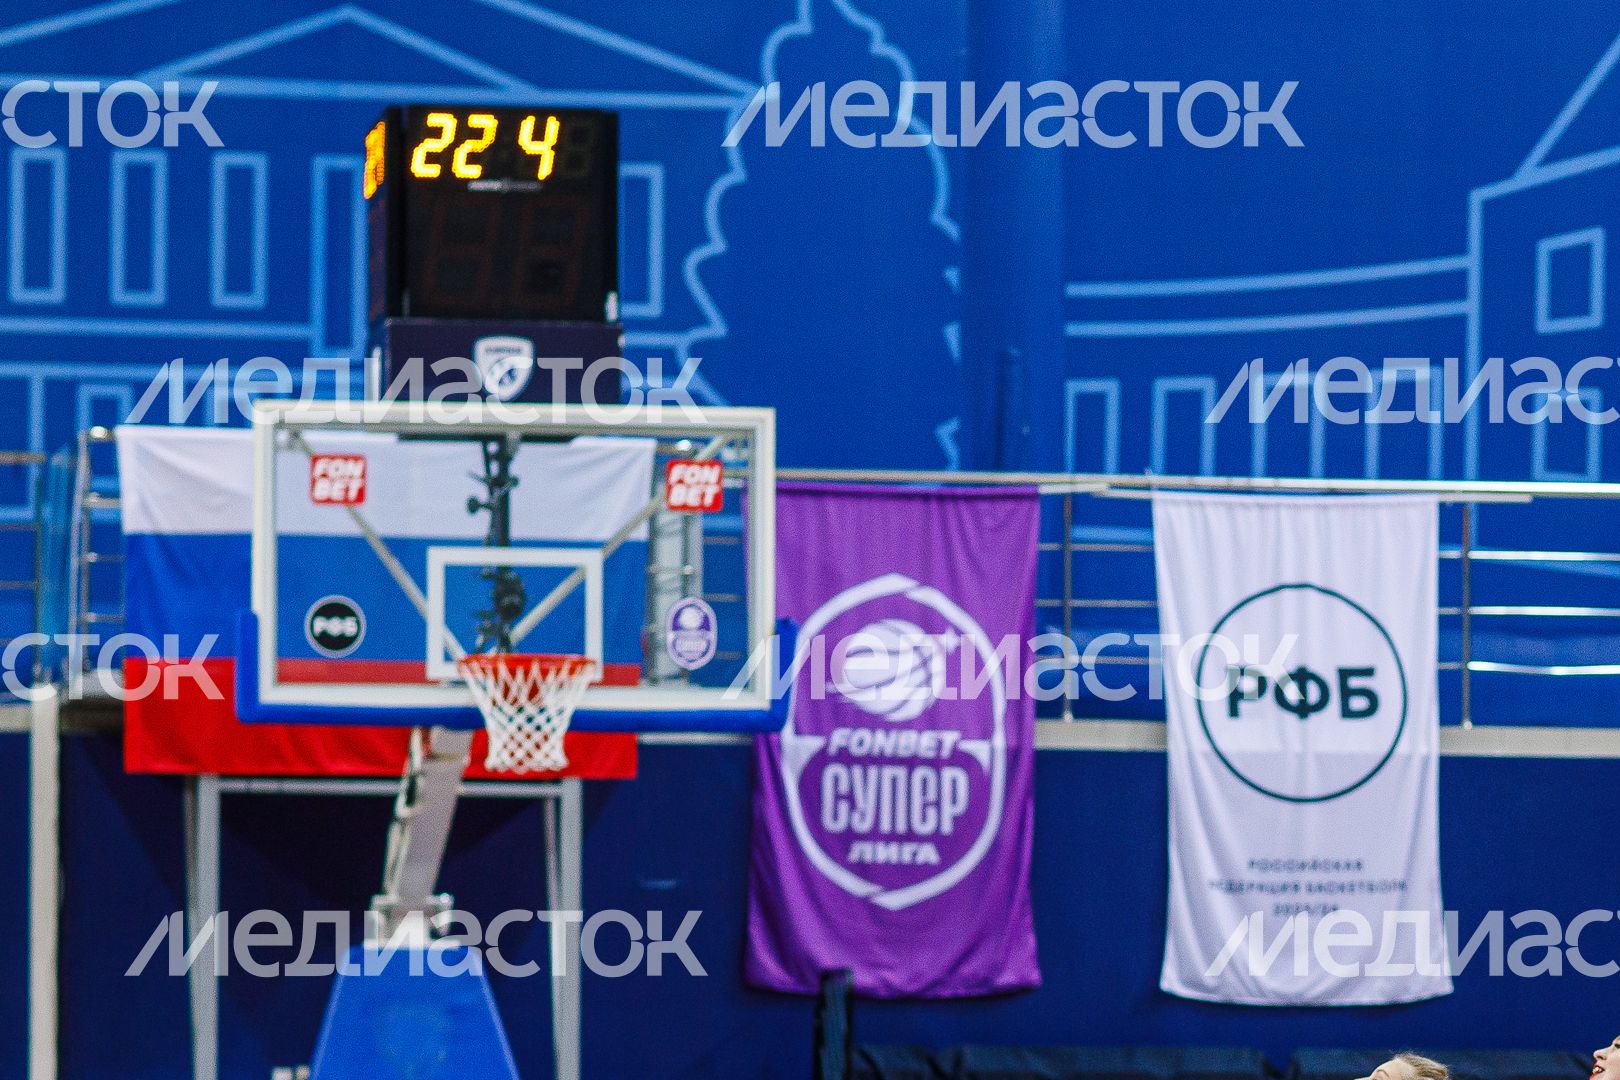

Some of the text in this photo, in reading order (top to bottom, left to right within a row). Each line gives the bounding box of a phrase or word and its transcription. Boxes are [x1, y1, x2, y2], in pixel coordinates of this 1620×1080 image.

[314, 459, 363, 478] FON
[670, 464, 721, 485] FON
[314, 478, 361, 500] BET
[670, 484, 720, 507] BET
[1227, 664, 1379, 719] РФБ
[828, 727, 961, 758] FONBET
[848, 842, 940, 865] ЛИГА
